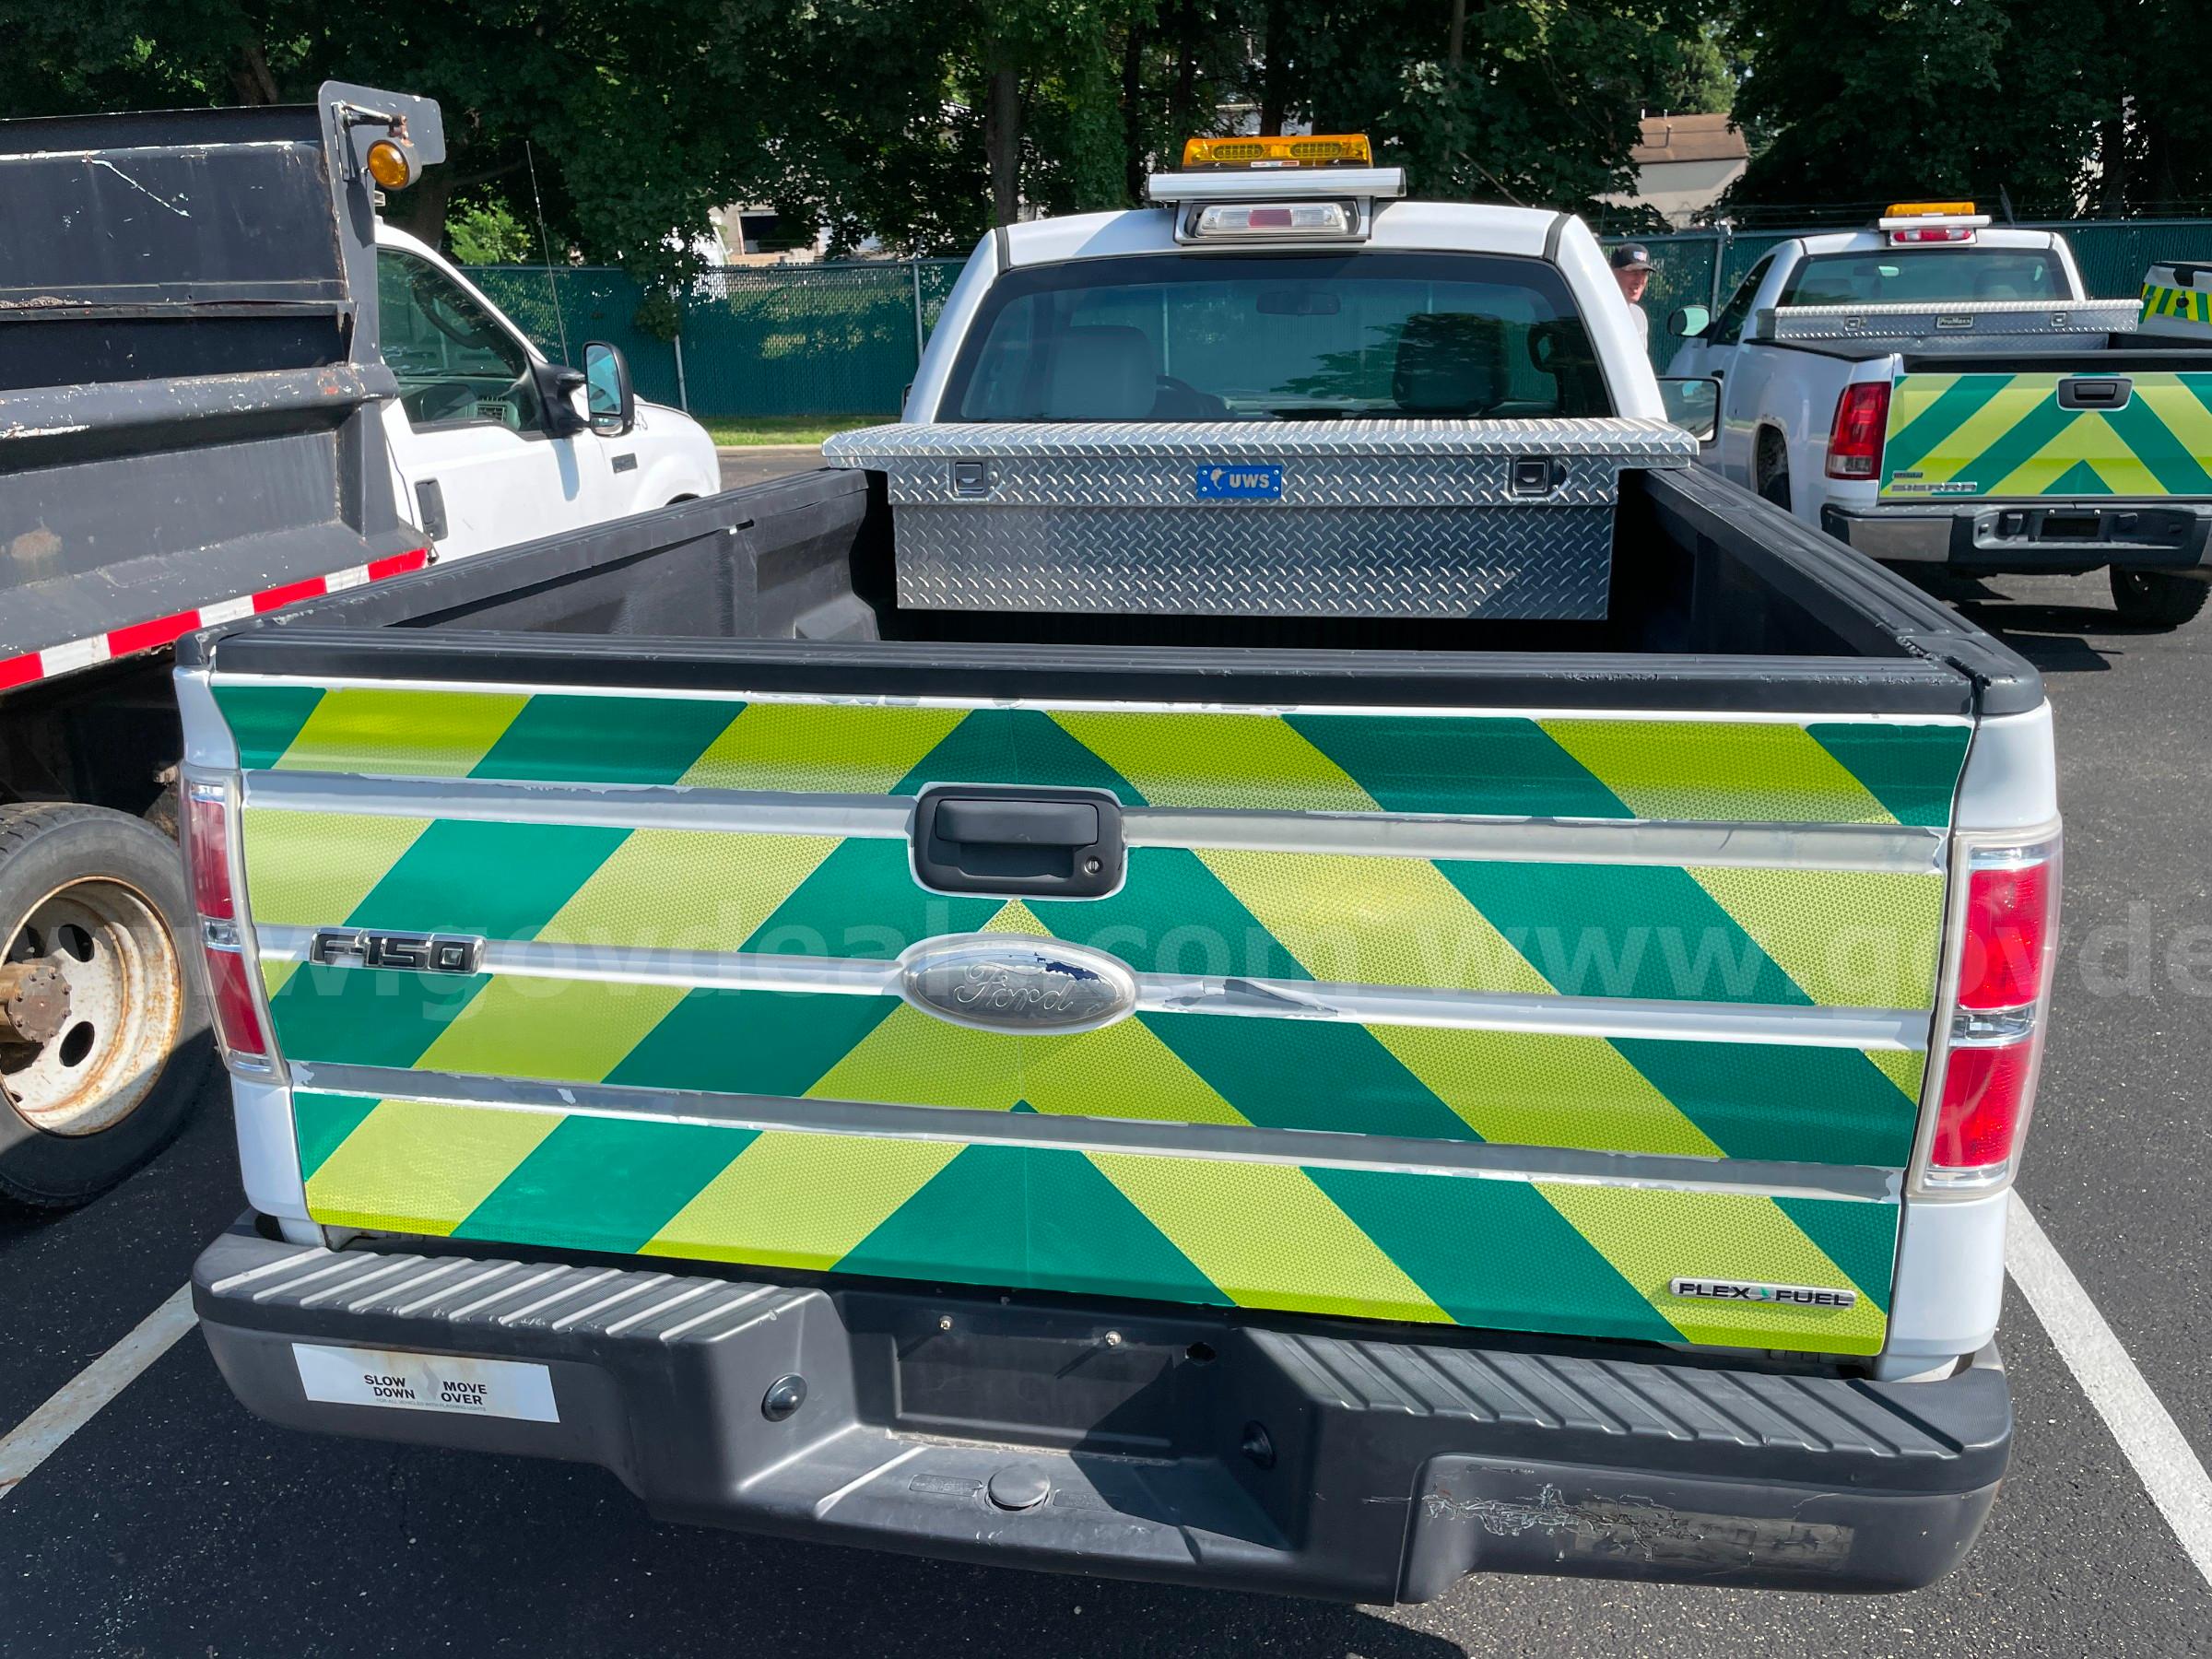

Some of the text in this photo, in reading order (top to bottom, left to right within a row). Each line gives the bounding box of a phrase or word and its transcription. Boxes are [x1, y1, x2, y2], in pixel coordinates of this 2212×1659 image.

[1229, 473, 1270, 488] UWS
[1891, 482, 1977, 492] SIERRA
[954, 962, 1079, 1012] Ford
[1678, 1282, 1850, 1306] FLEX FUEL
[364, 1374, 406, 1387] SLOW
[442, 1381, 488, 1394] MOVE
[373, 1386, 416, 1400] DOWN
[441, 1392, 483, 1406] OVER
